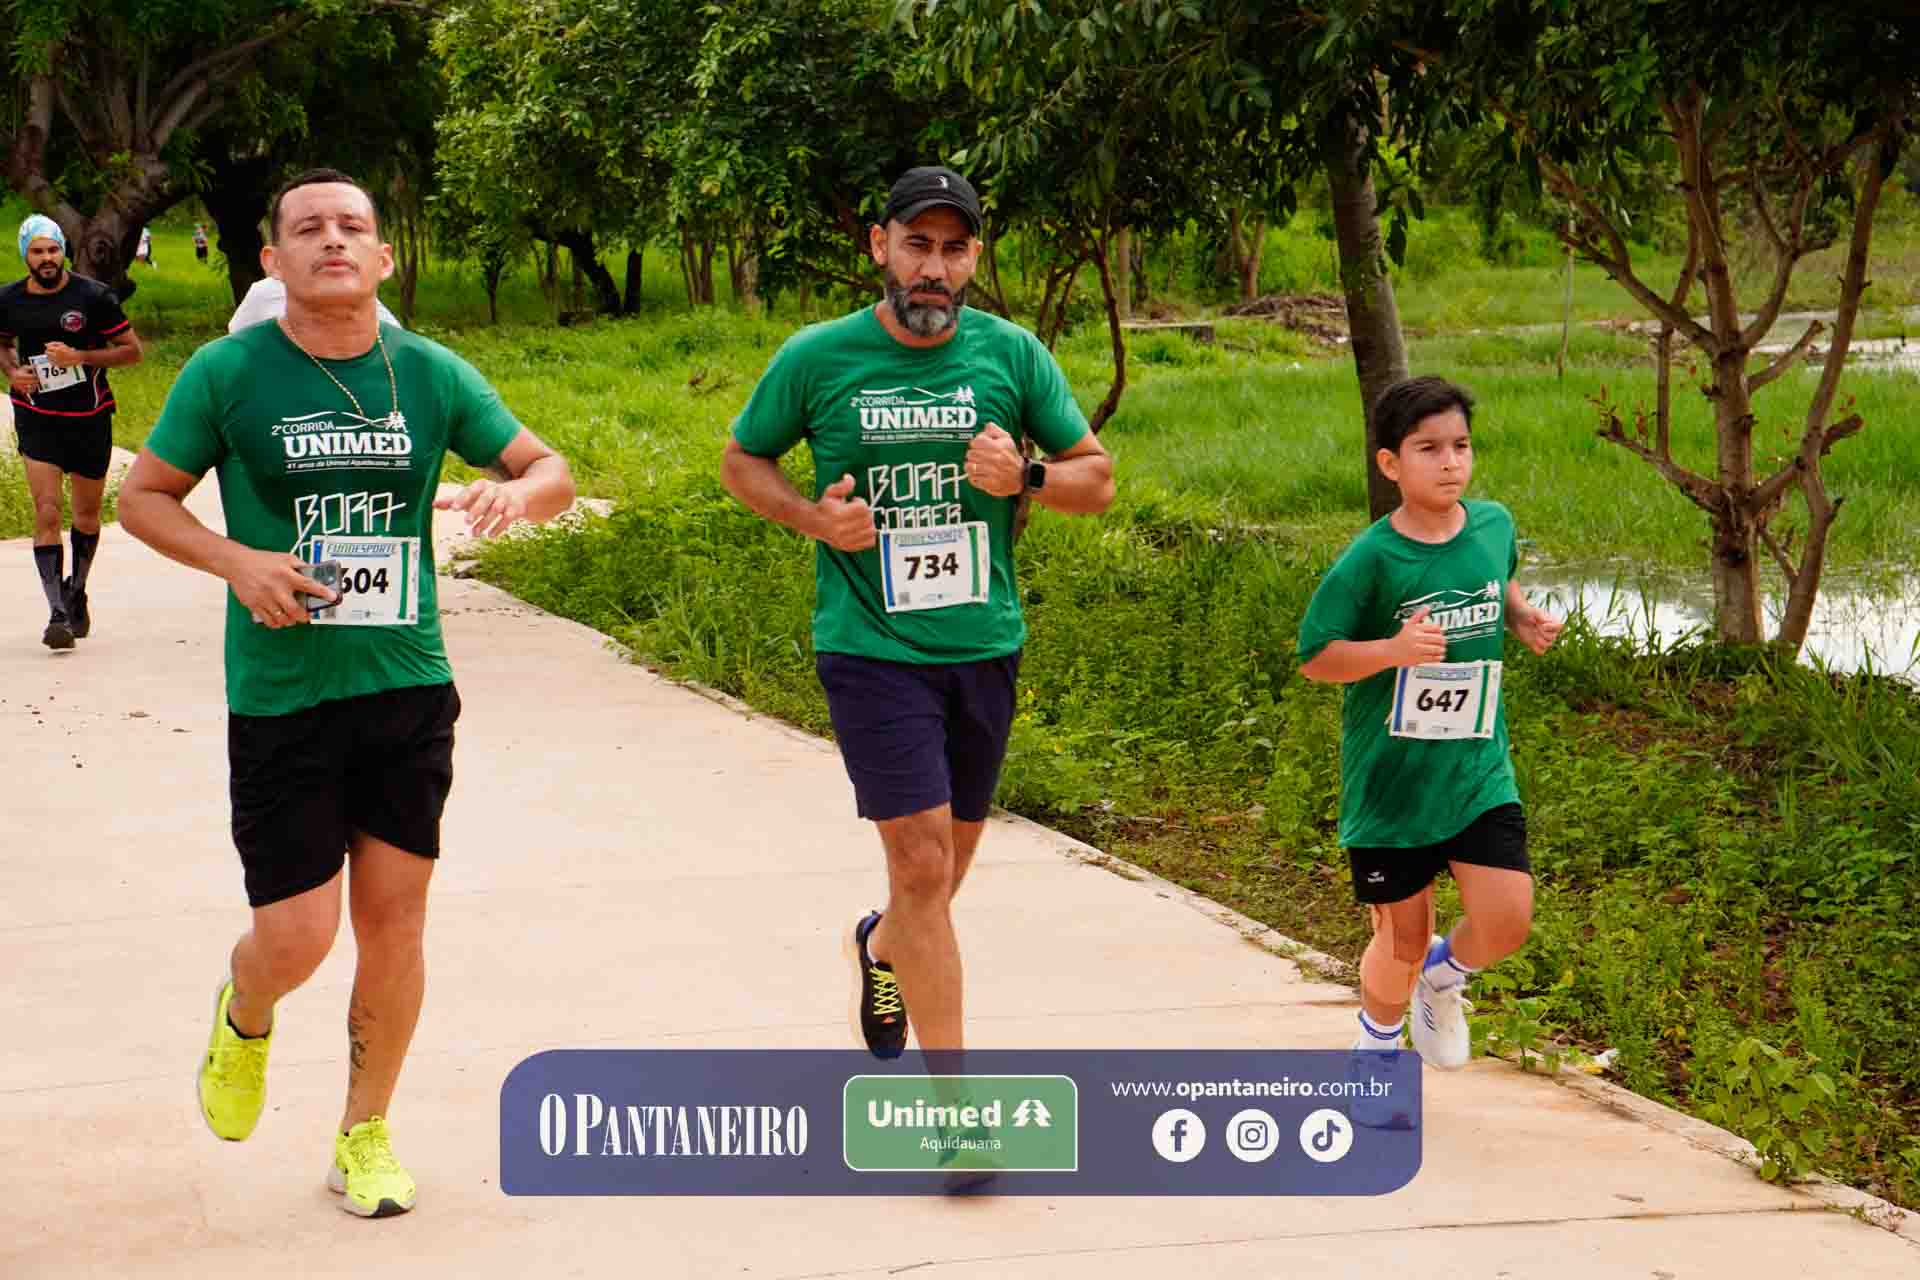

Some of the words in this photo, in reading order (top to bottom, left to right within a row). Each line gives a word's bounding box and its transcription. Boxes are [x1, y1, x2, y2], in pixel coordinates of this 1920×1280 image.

[282, 421, 335, 434] CORRIDA
[860, 406, 977, 430] UNIMED
[283, 432, 412, 458] UNIMED
[868, 461, 969, 508] BORA
[290, 491, 407, 554] BORA
[904, 551, 959, 581] 734
[1416, 688, 1469, 712] 647
